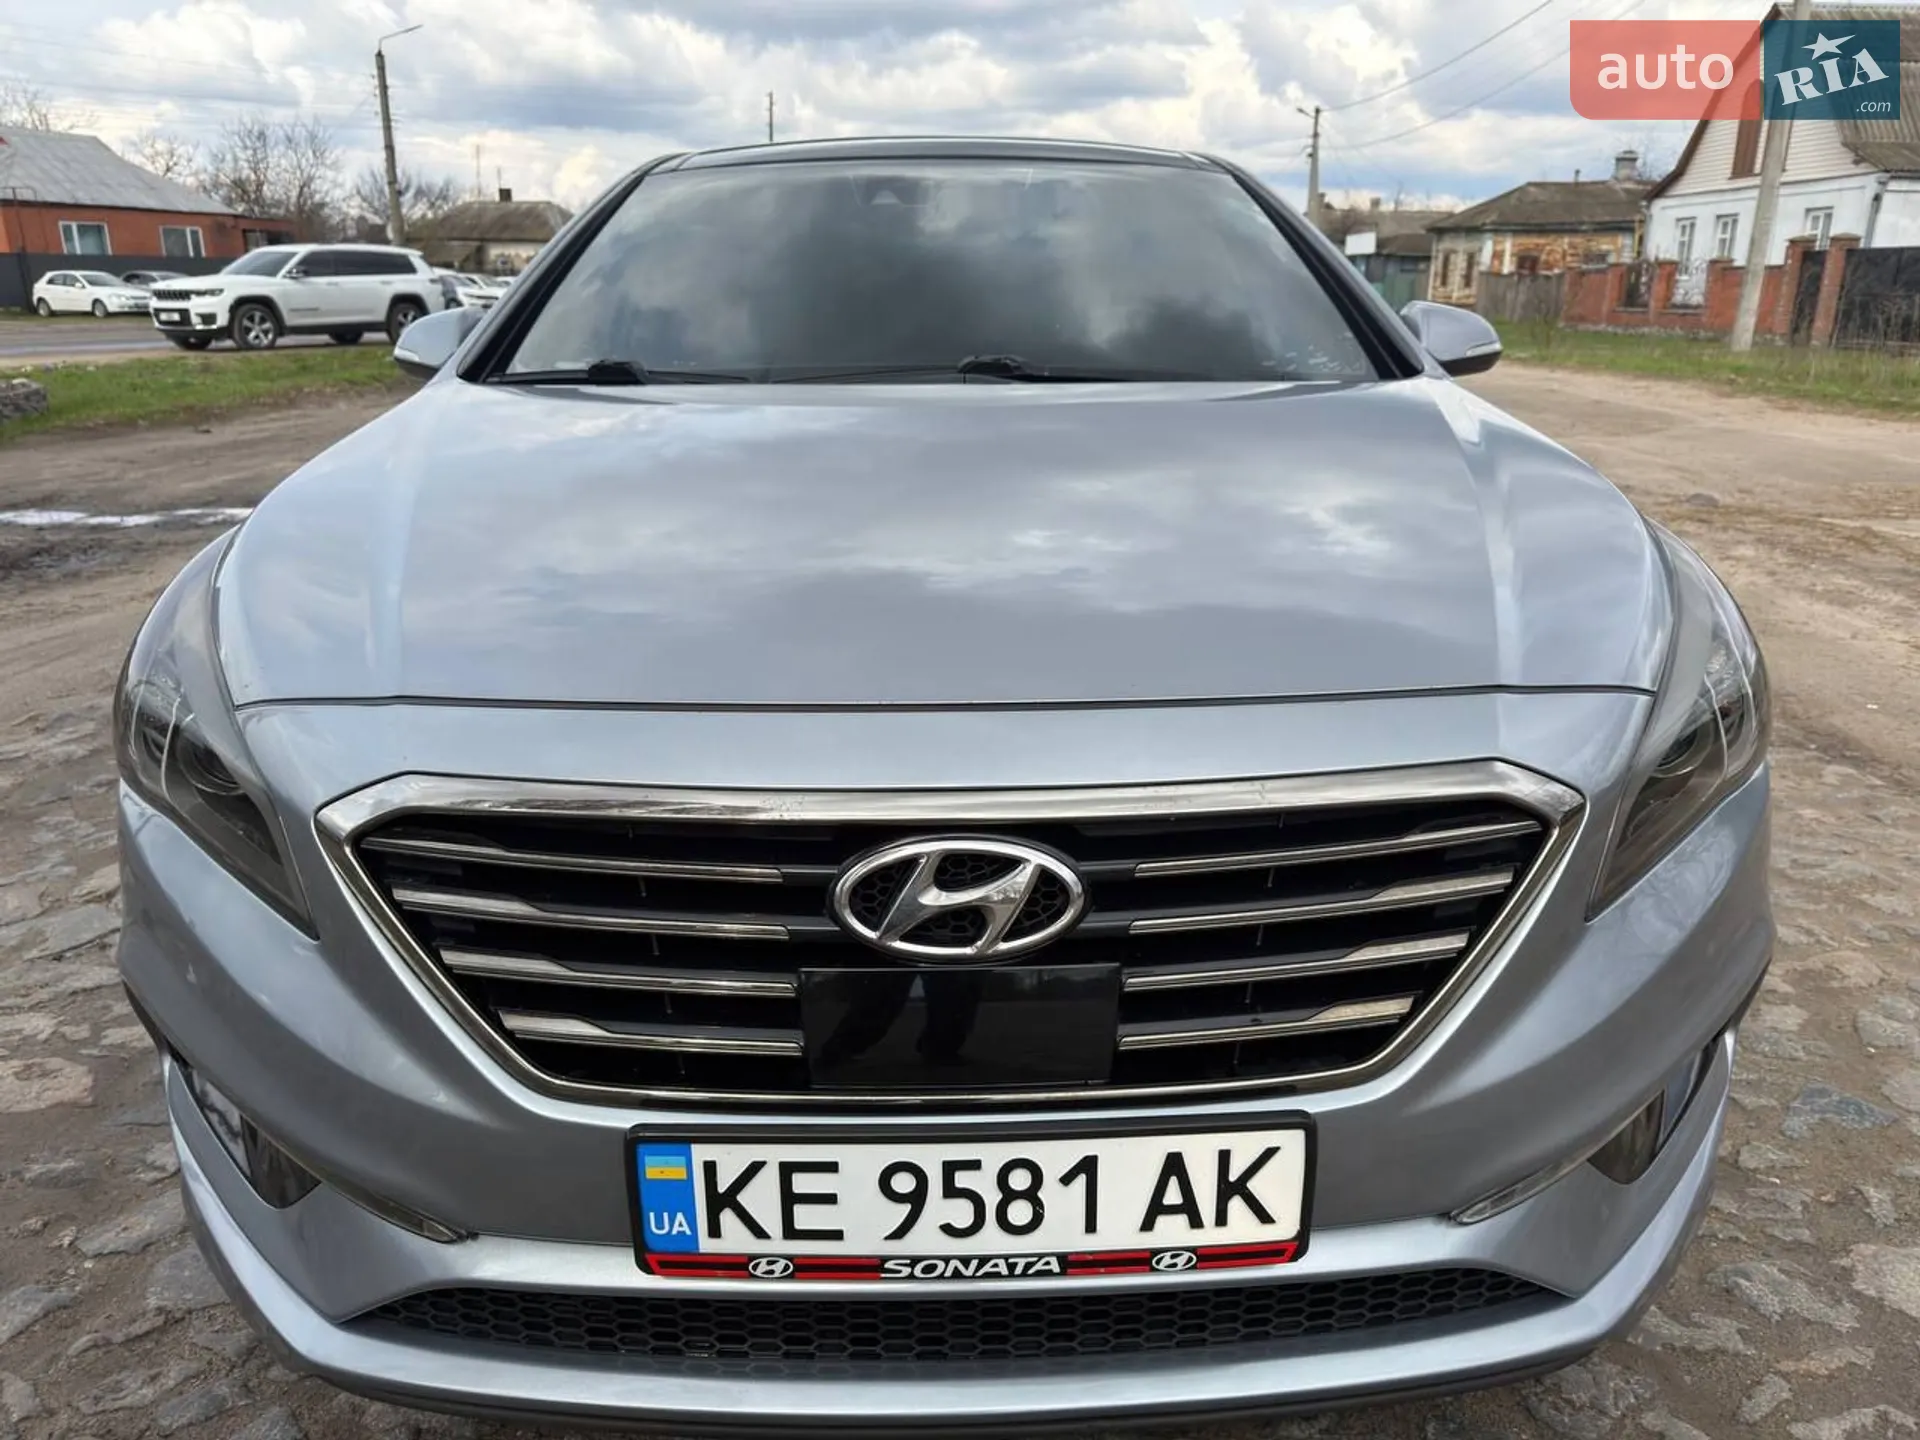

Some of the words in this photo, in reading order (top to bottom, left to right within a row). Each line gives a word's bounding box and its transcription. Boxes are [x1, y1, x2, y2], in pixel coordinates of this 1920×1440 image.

[703, 1160, 844, 1240] KE
[878, 1154, 1098, 1241] 9581
[1139, 1146, 1281, 1232] AK
[650, 1212, 691, 1236] UA
[880, 1256, 1061, 1278] SONATA
